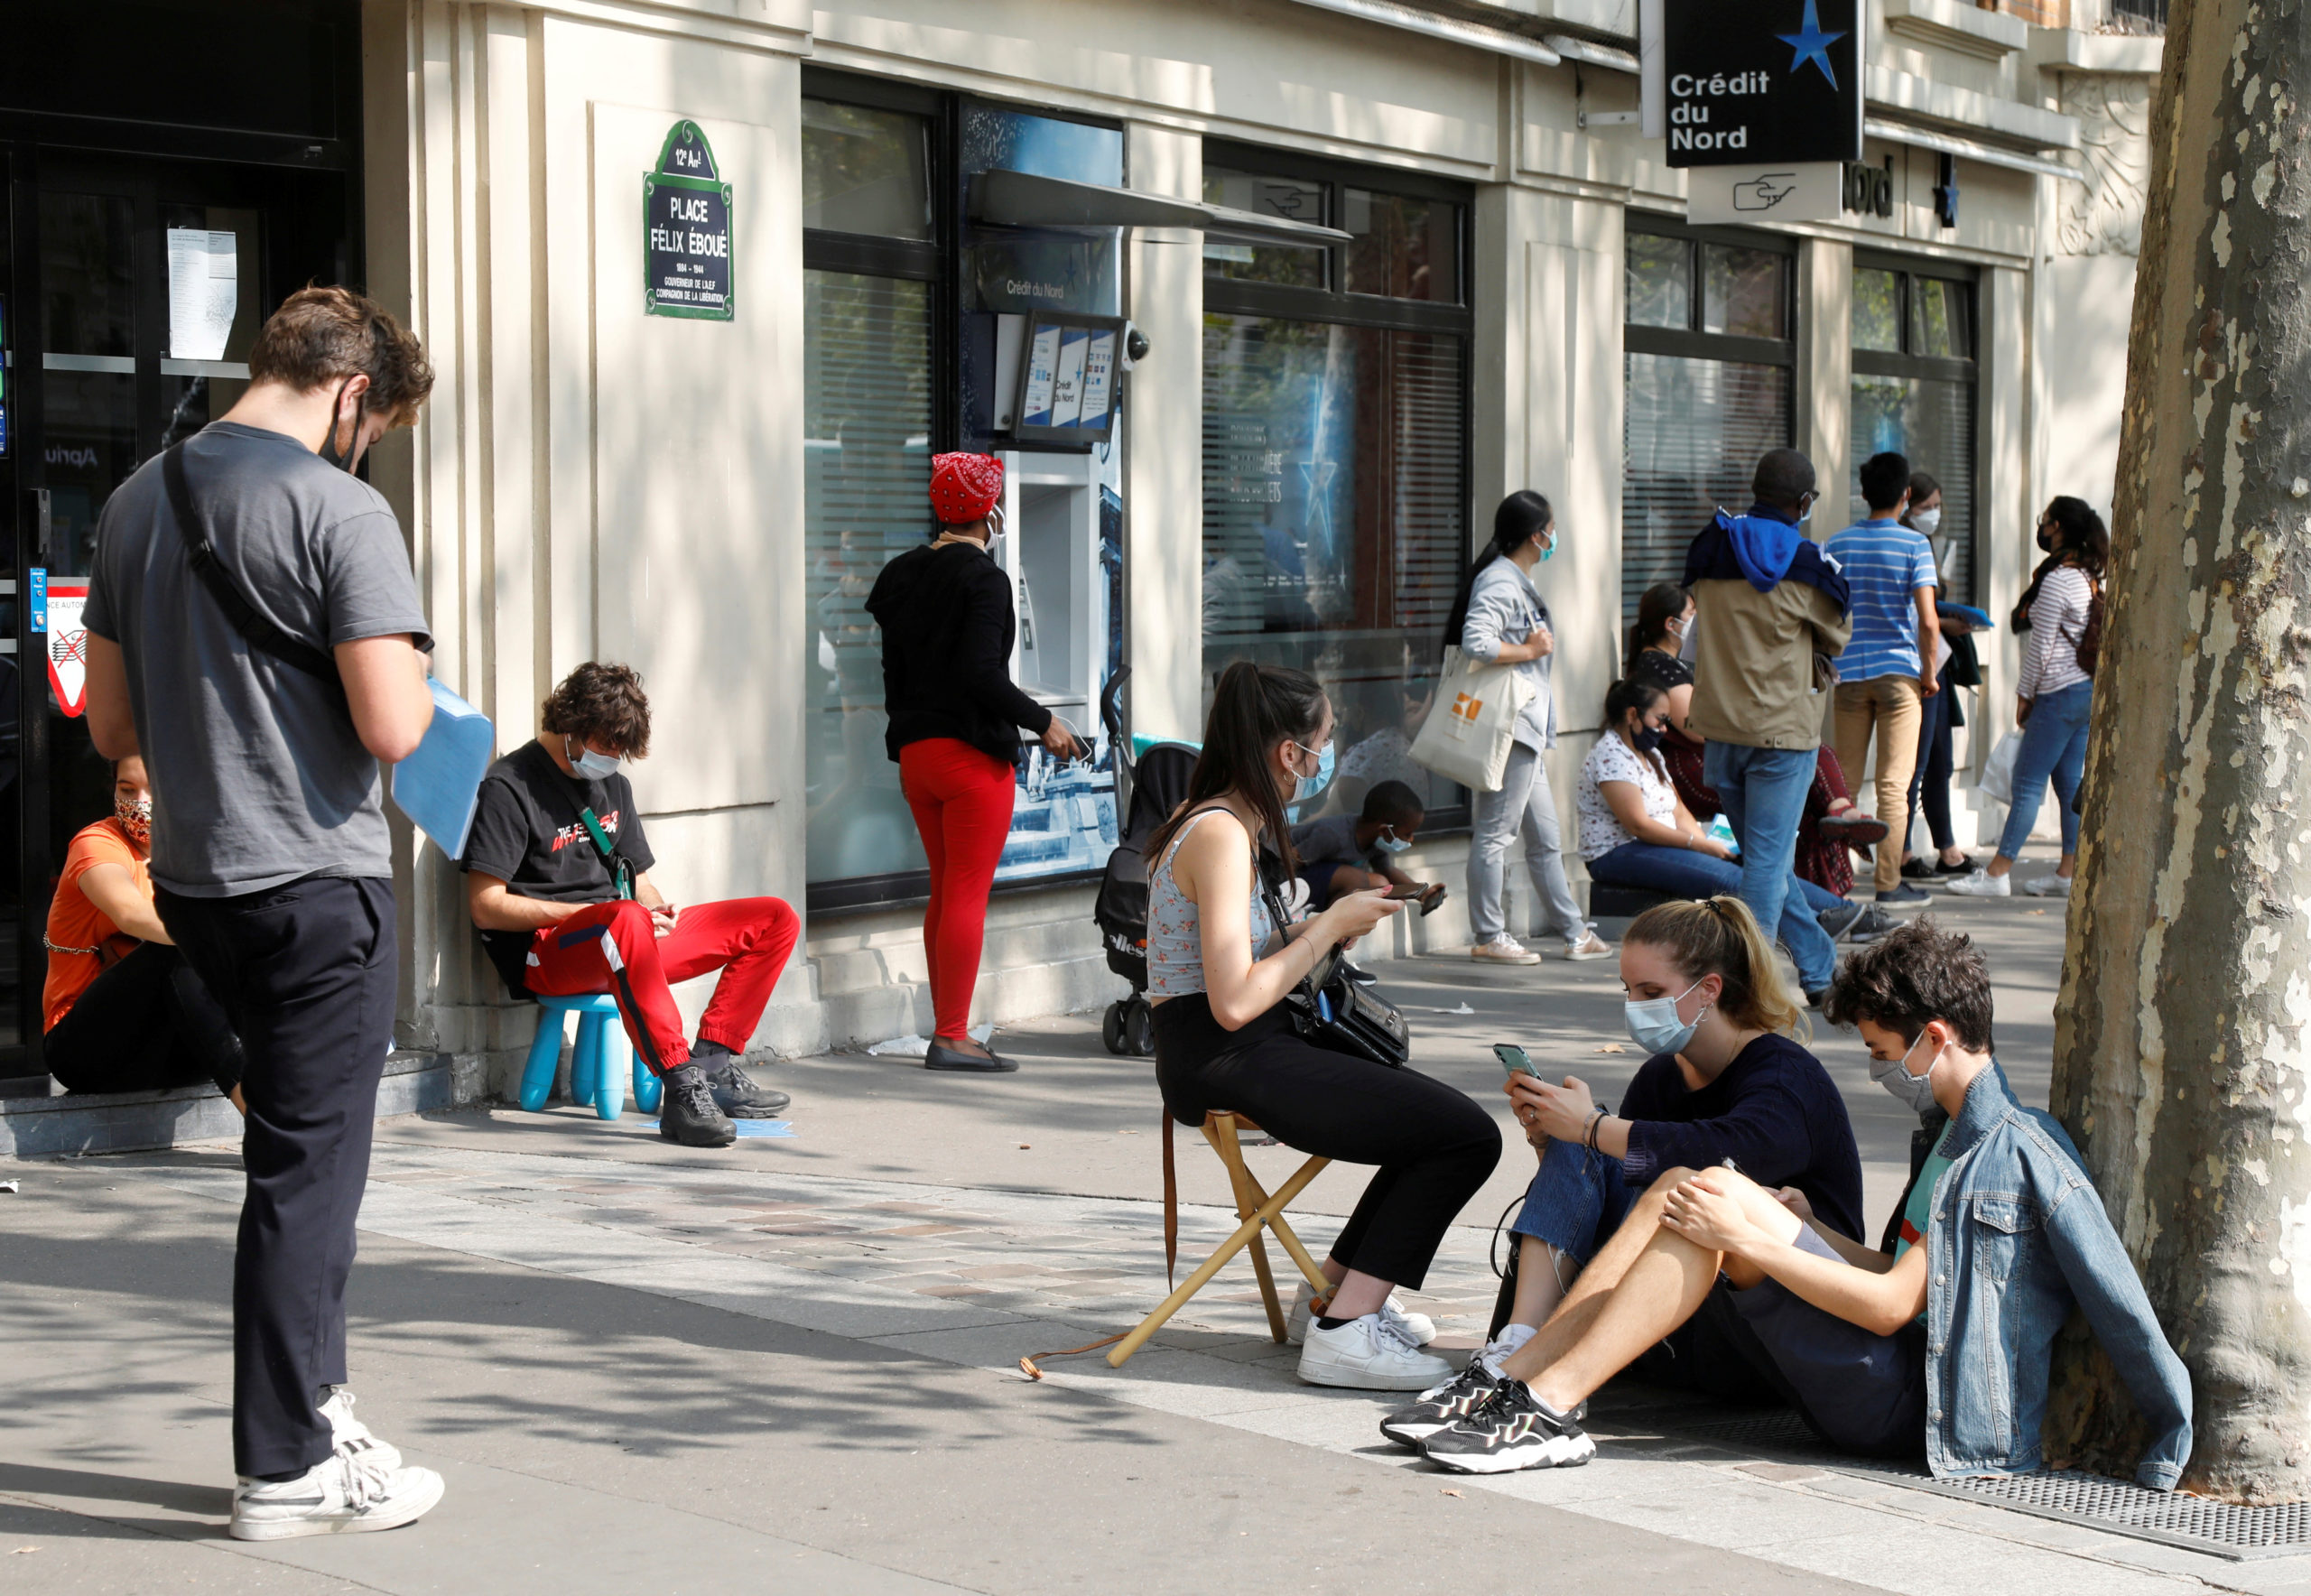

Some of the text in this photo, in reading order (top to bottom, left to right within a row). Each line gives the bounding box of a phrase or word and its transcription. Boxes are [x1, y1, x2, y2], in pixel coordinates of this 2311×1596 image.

[1671, 71, 1769, 97] Crédit
[1671, 102, 1709, 124] du
[1672, 125, 1747, 150] Nord
[670, 197, 708, 222] PLACE
[651, 223, 728, 258] FÉLIX ÉBOUÉ
[676, 263, 687, 273] 1884
[693, 264, 704, 274] 1944
[664, 276, 694, 288] GOUVERNEUR
[694, 279, 701, 289] DE
[1007, 279, 1064, 299] Crédit du Nord
[655, 288, 724, 303] COMPAGNON DE LA LIBÉRATION
[1063, 393, 1074, 403] Nord
